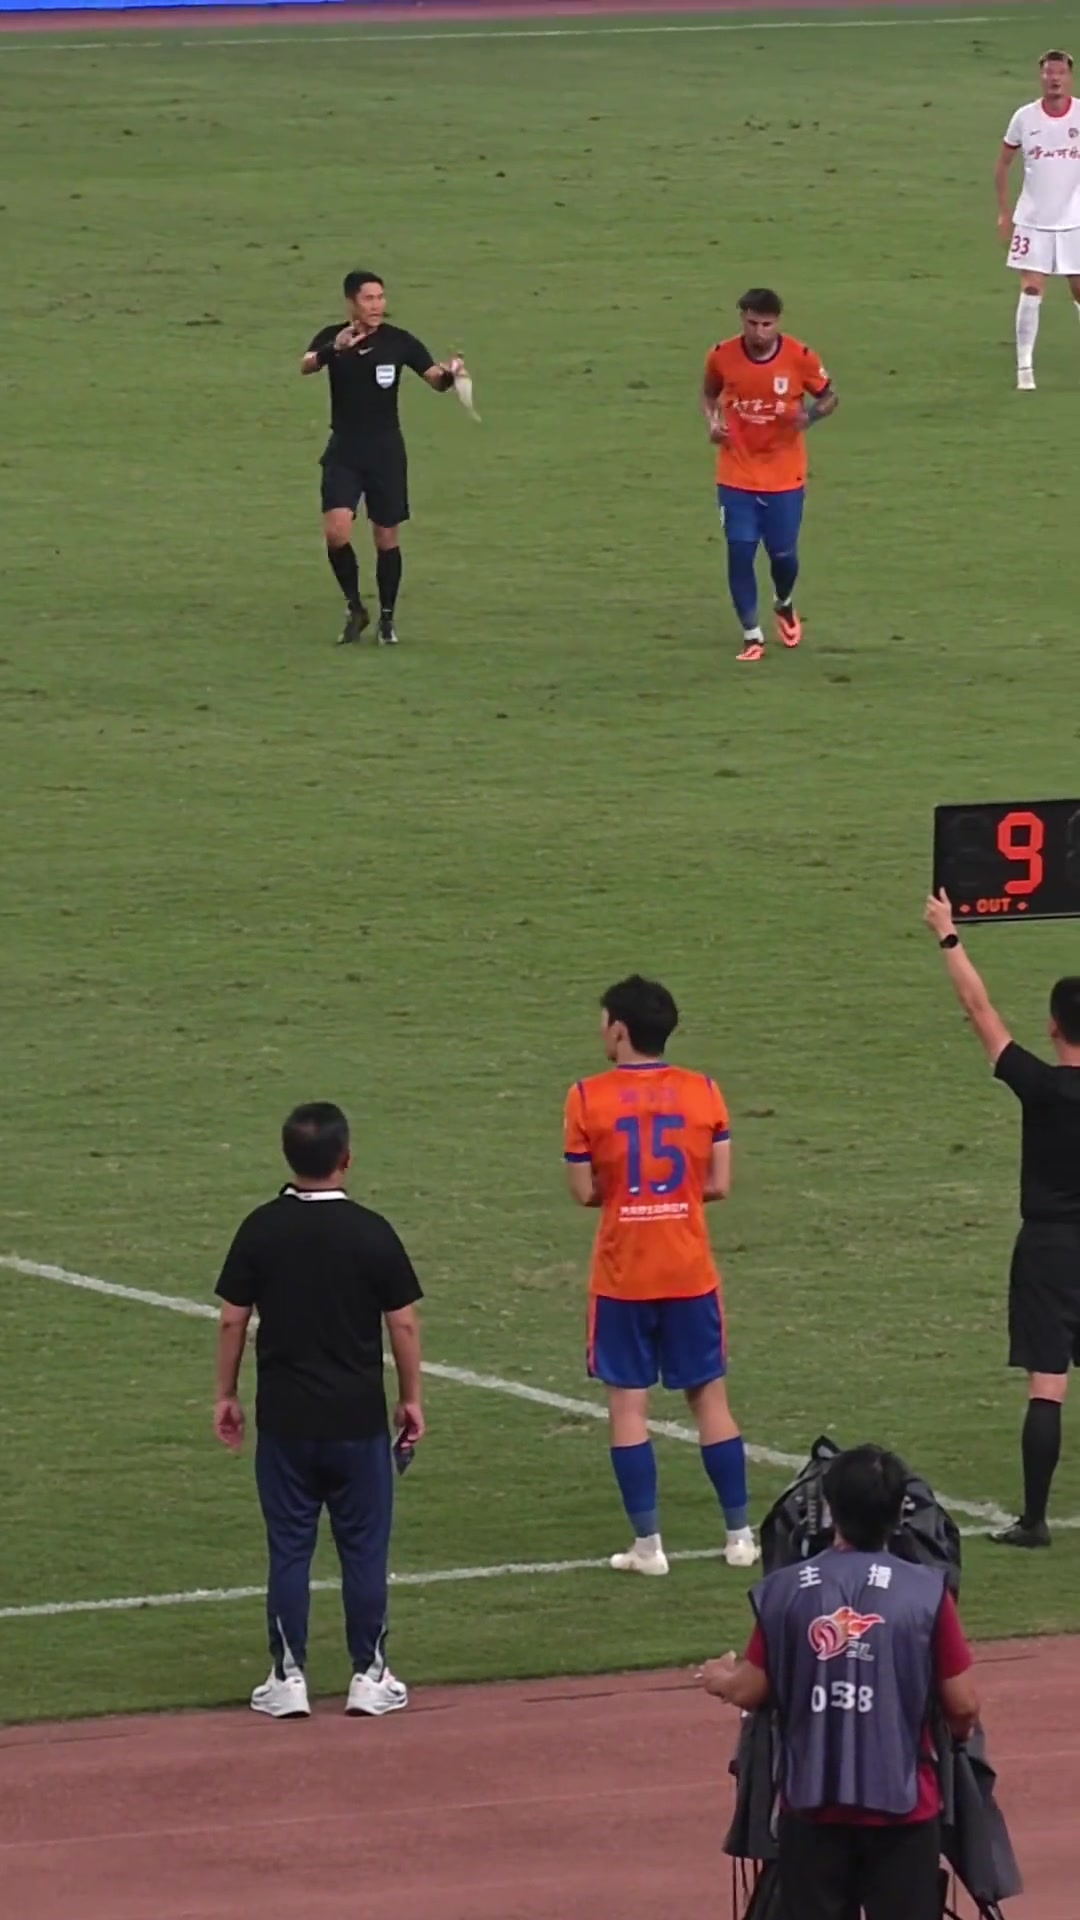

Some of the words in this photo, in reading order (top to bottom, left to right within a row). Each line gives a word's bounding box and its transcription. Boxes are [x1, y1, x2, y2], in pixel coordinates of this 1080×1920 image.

[1011, 235, 1030, 255] 33
[997, 811, 1043, 895] 9
[976, 897, 1012, 913] OUT
[615, 1114, 687, 1197] 15
